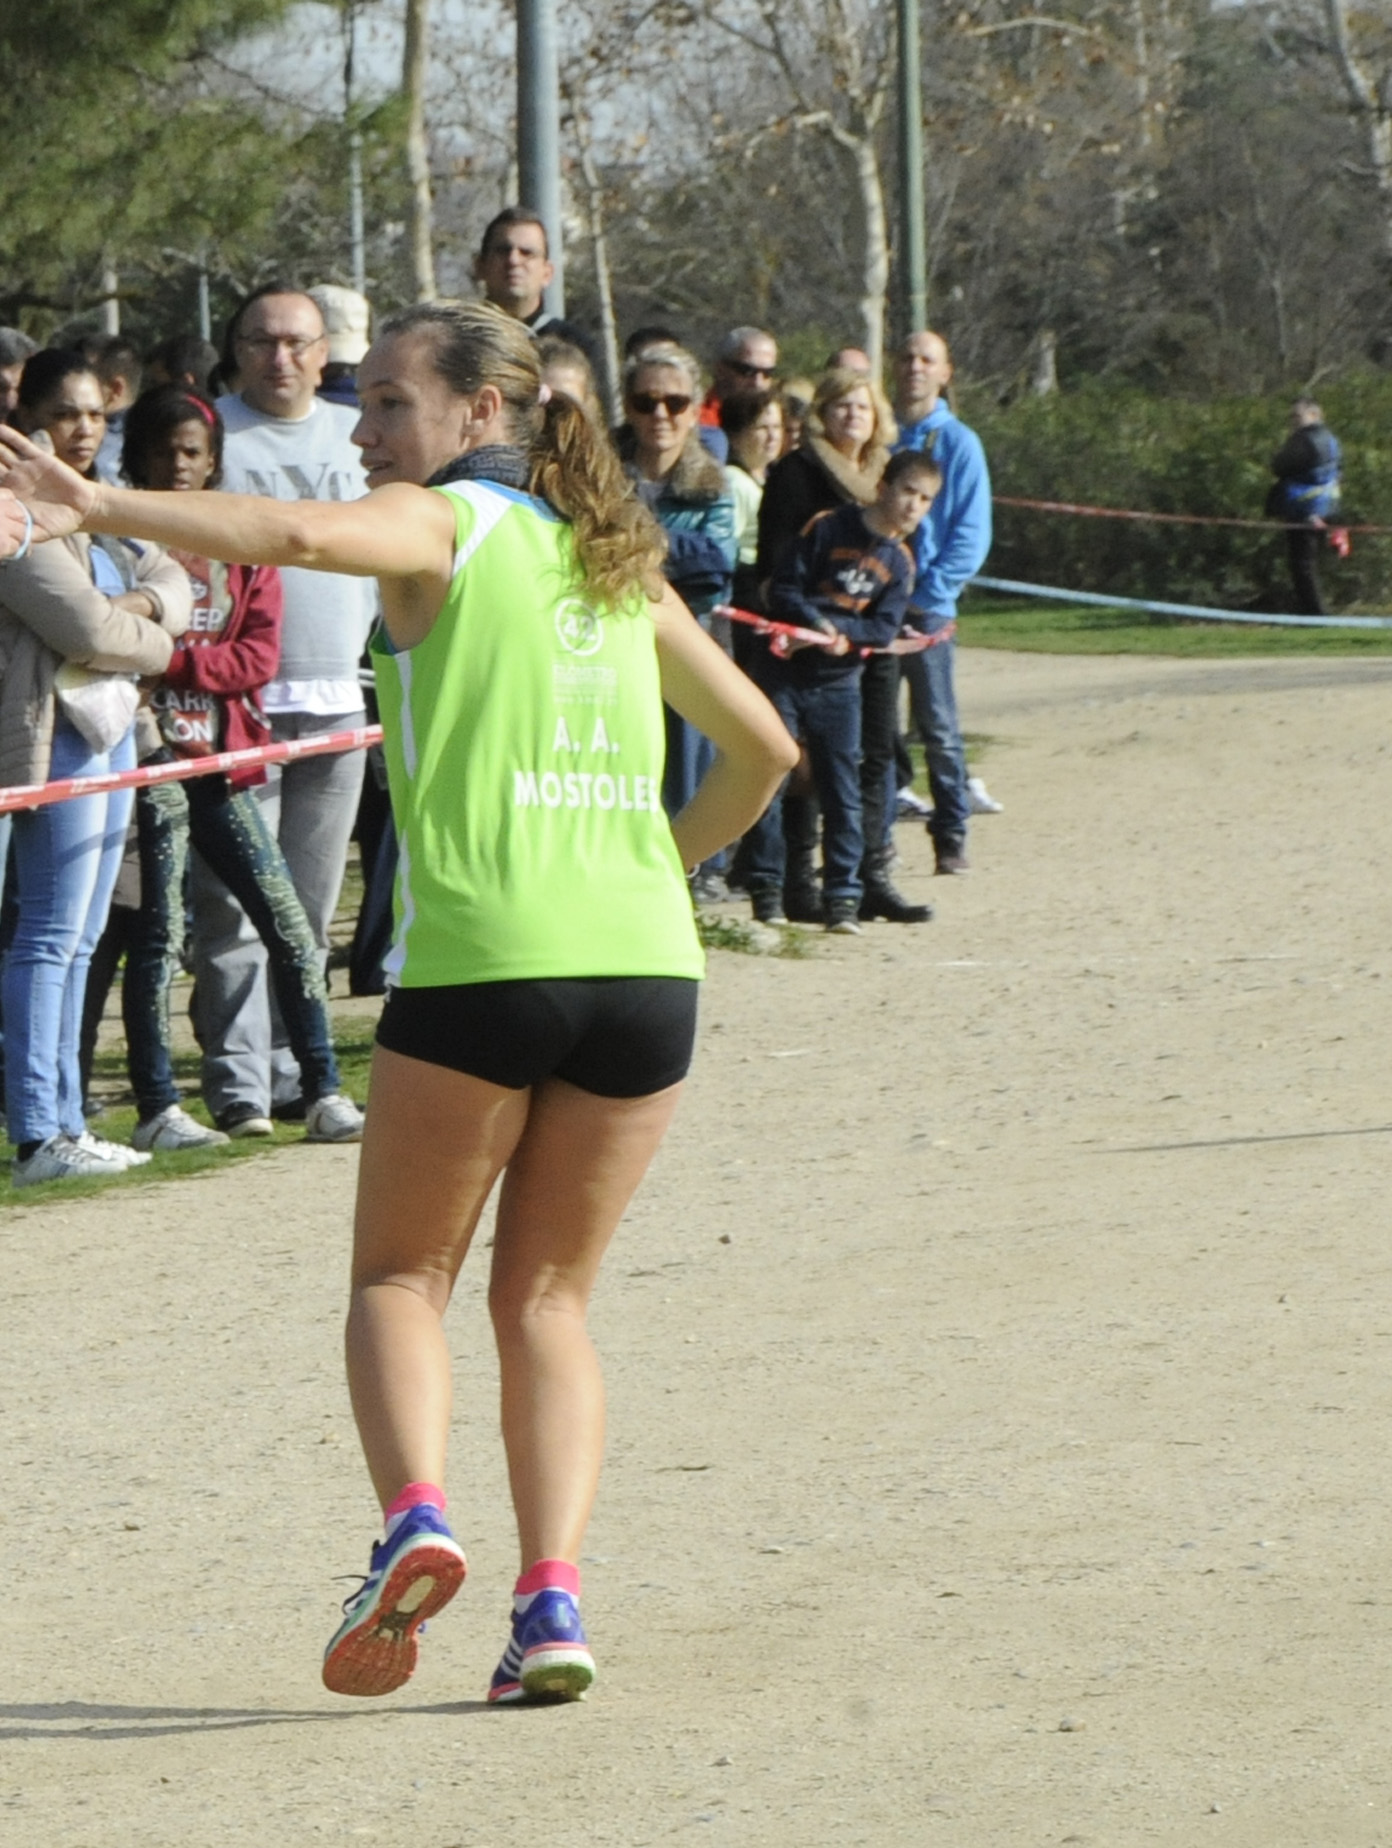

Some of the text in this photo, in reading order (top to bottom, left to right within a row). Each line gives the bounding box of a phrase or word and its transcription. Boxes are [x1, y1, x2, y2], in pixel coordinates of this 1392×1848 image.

[243, 463, 352, 500] NYC
[562, 614, 598, 642] 42
[173, 717, 214, 743] ON
